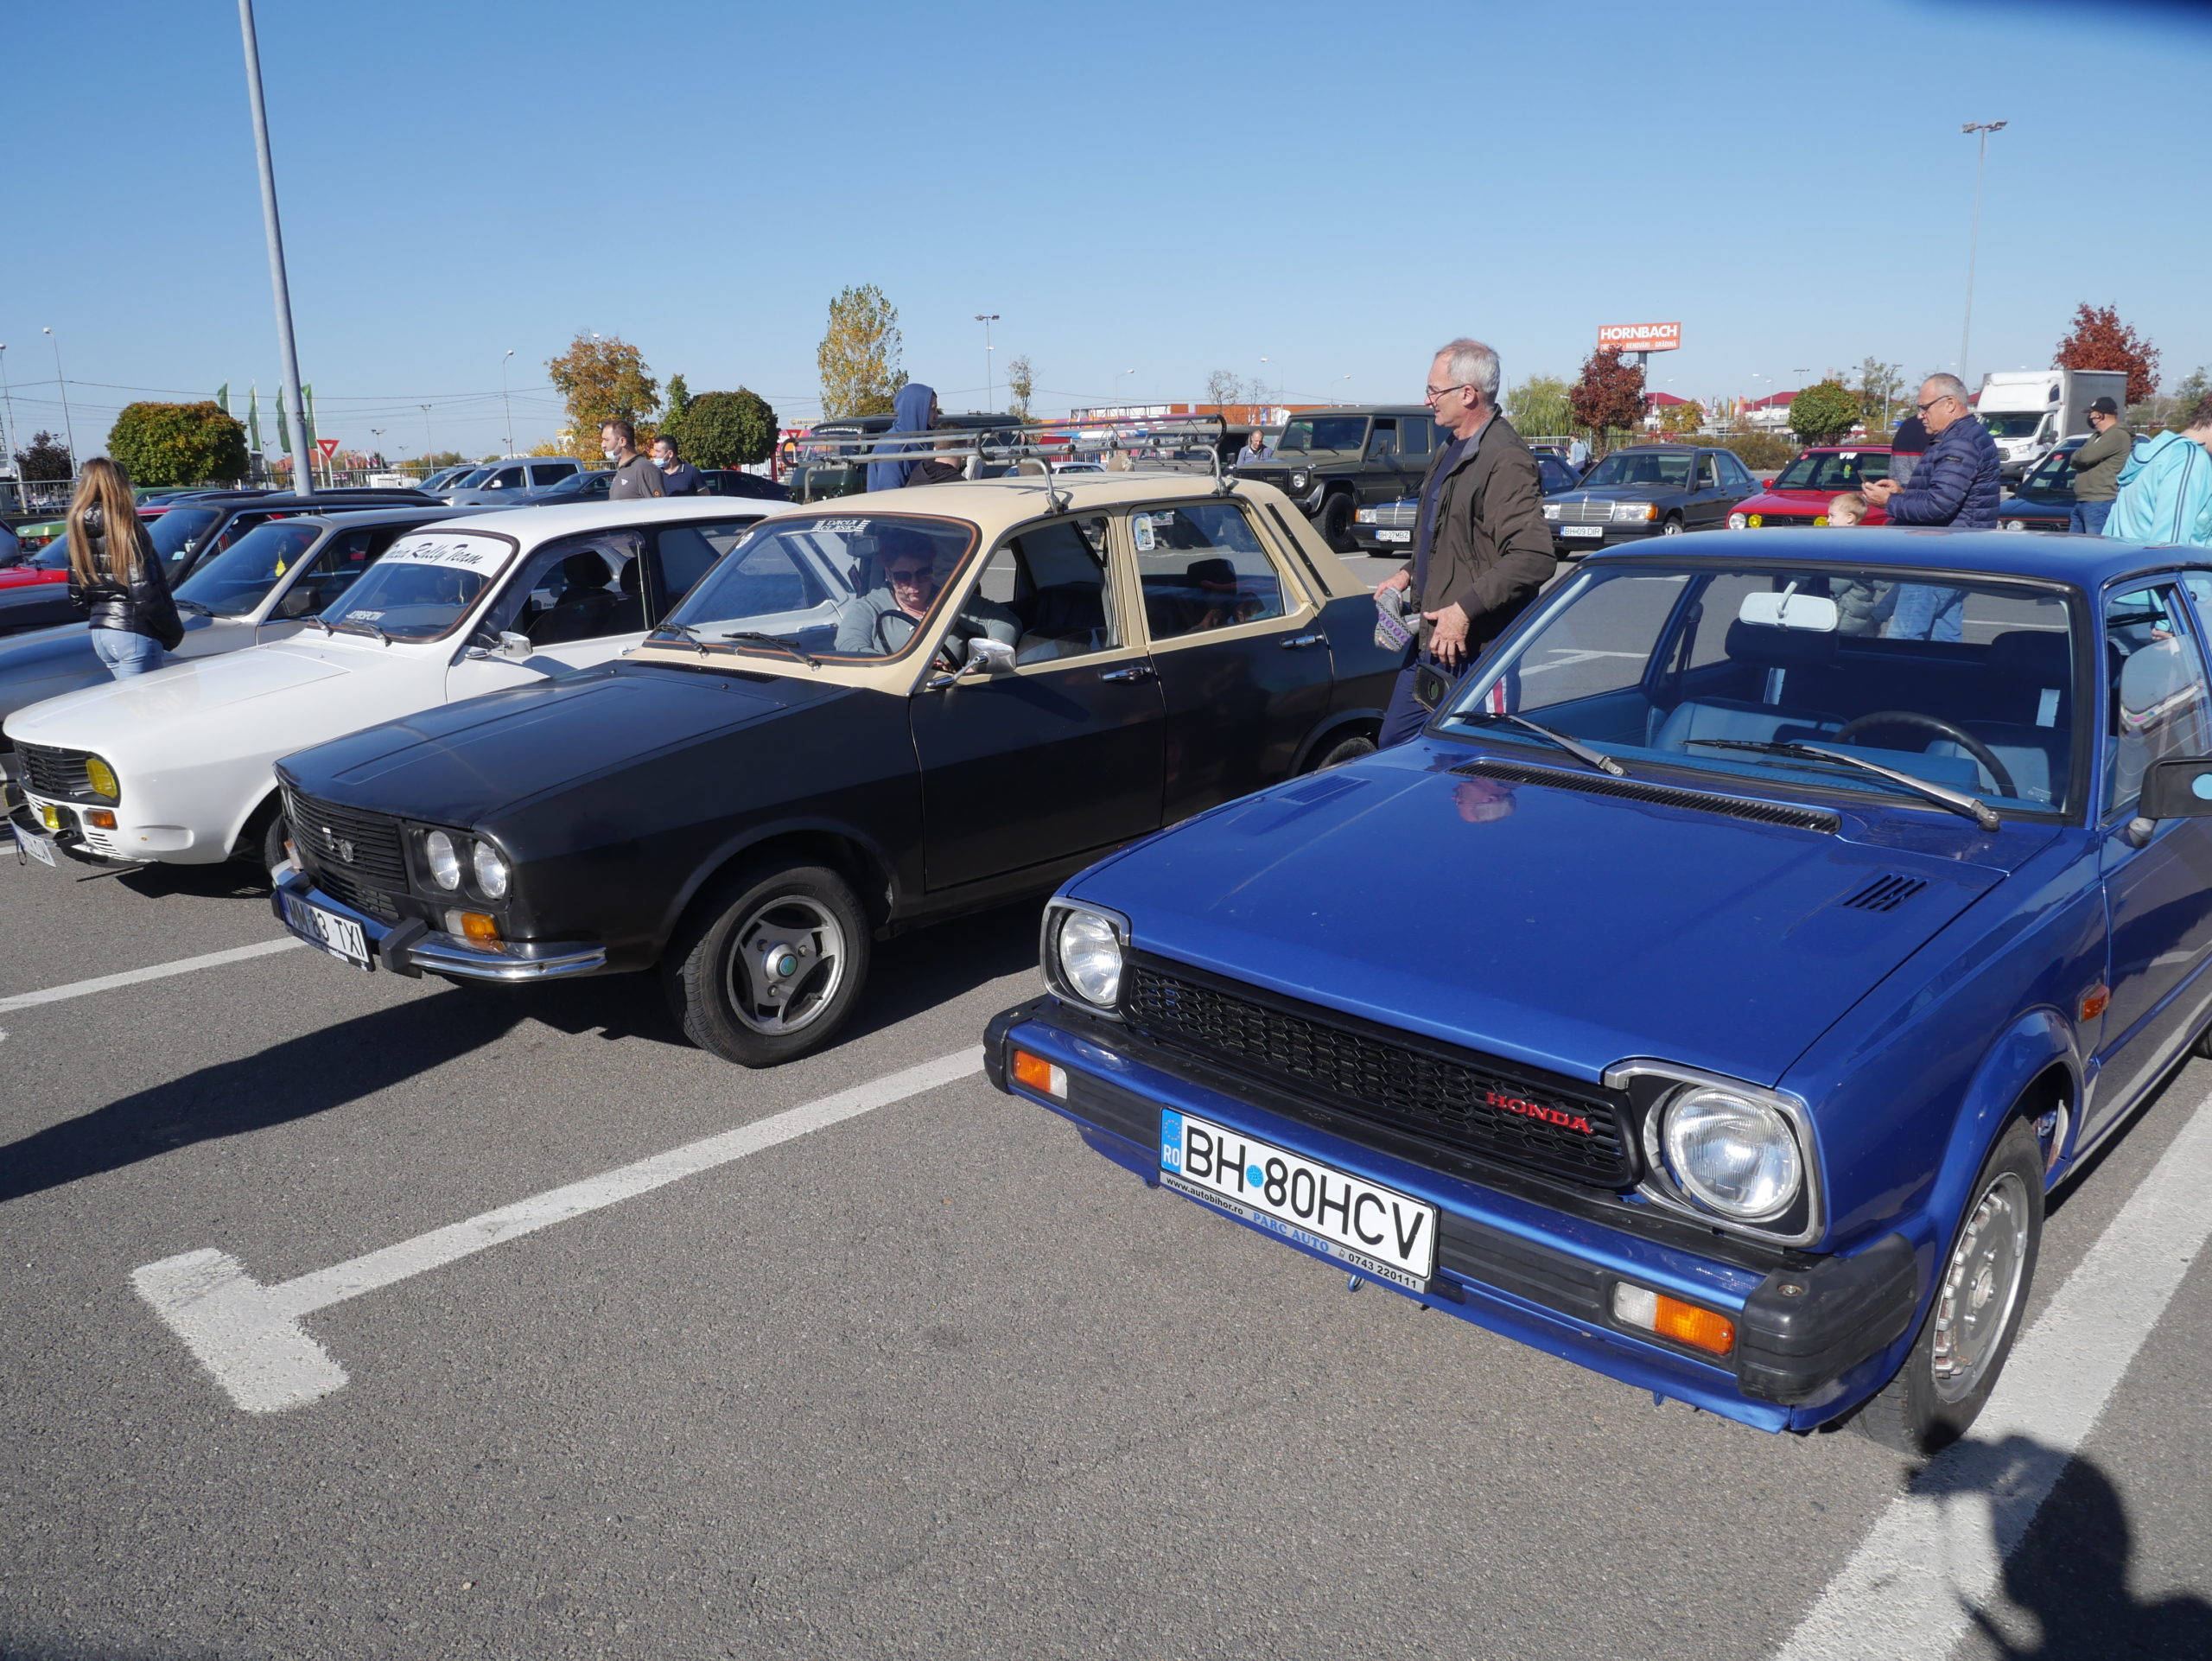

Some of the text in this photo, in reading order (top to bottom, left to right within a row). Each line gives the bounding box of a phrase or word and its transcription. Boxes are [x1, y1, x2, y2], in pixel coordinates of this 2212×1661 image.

[1600, 325, 1678, 340] HORNBACH
[408, 542, 449, 563] Rally
[445, 544, 484, 565] Team
[286, 896, 310, 933] MM
[309, 907, 330, 942] 83
[334, 918, 365, 958] TXI
[1486, 1091, 1594, 1134] HONDA
[1163, 1143, 1180, 1167] RO
[1166, 1177, 1243, 1215] www.autobihor.ro
[1185, 1124, 1426, 1261] BH 80HCV
[1252, 1212, 1330, 1252] PARC AUTO
[1348, 1253, 1417, 1289] 0743 220111
